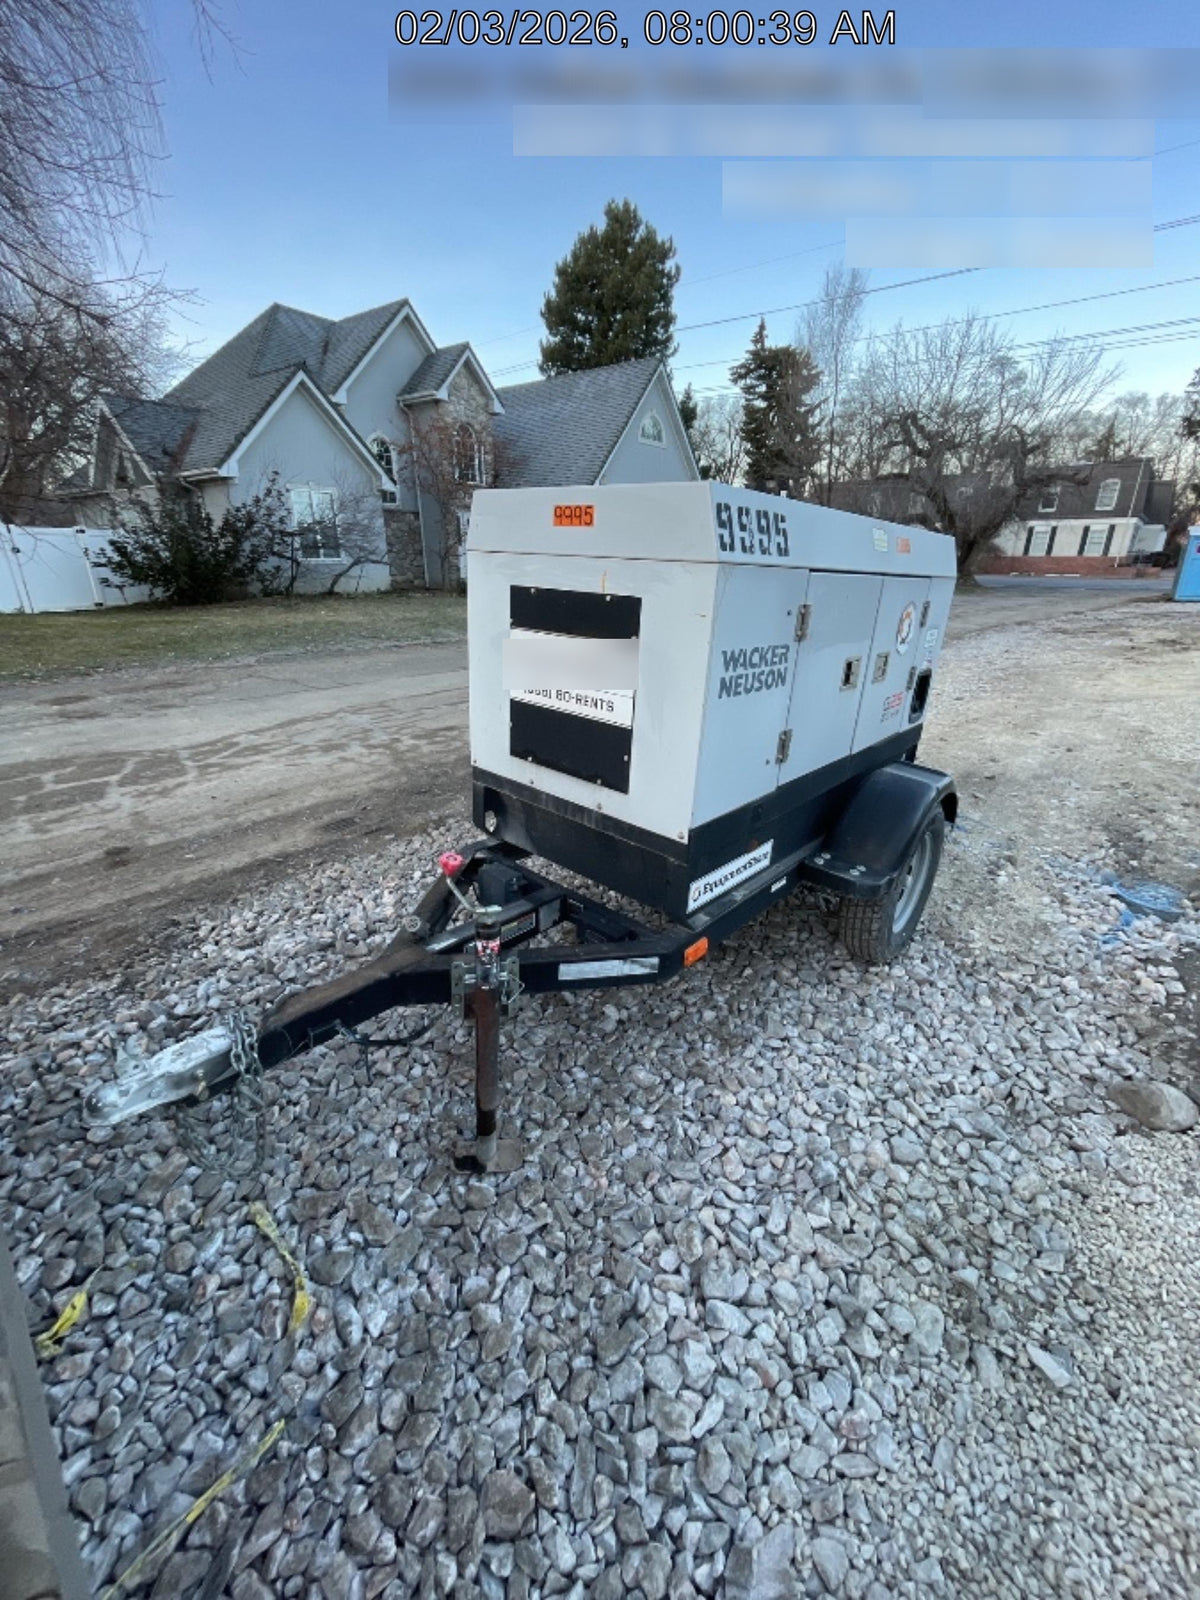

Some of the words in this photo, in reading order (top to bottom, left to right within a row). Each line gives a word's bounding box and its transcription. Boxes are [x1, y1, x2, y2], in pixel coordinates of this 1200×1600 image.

[554, 504, 593, 525] 9995
[716, 502, 790, 557] 9995
[721, 644, 790, 672] WACKER
[718, 667, 788, 699] NEUSON
